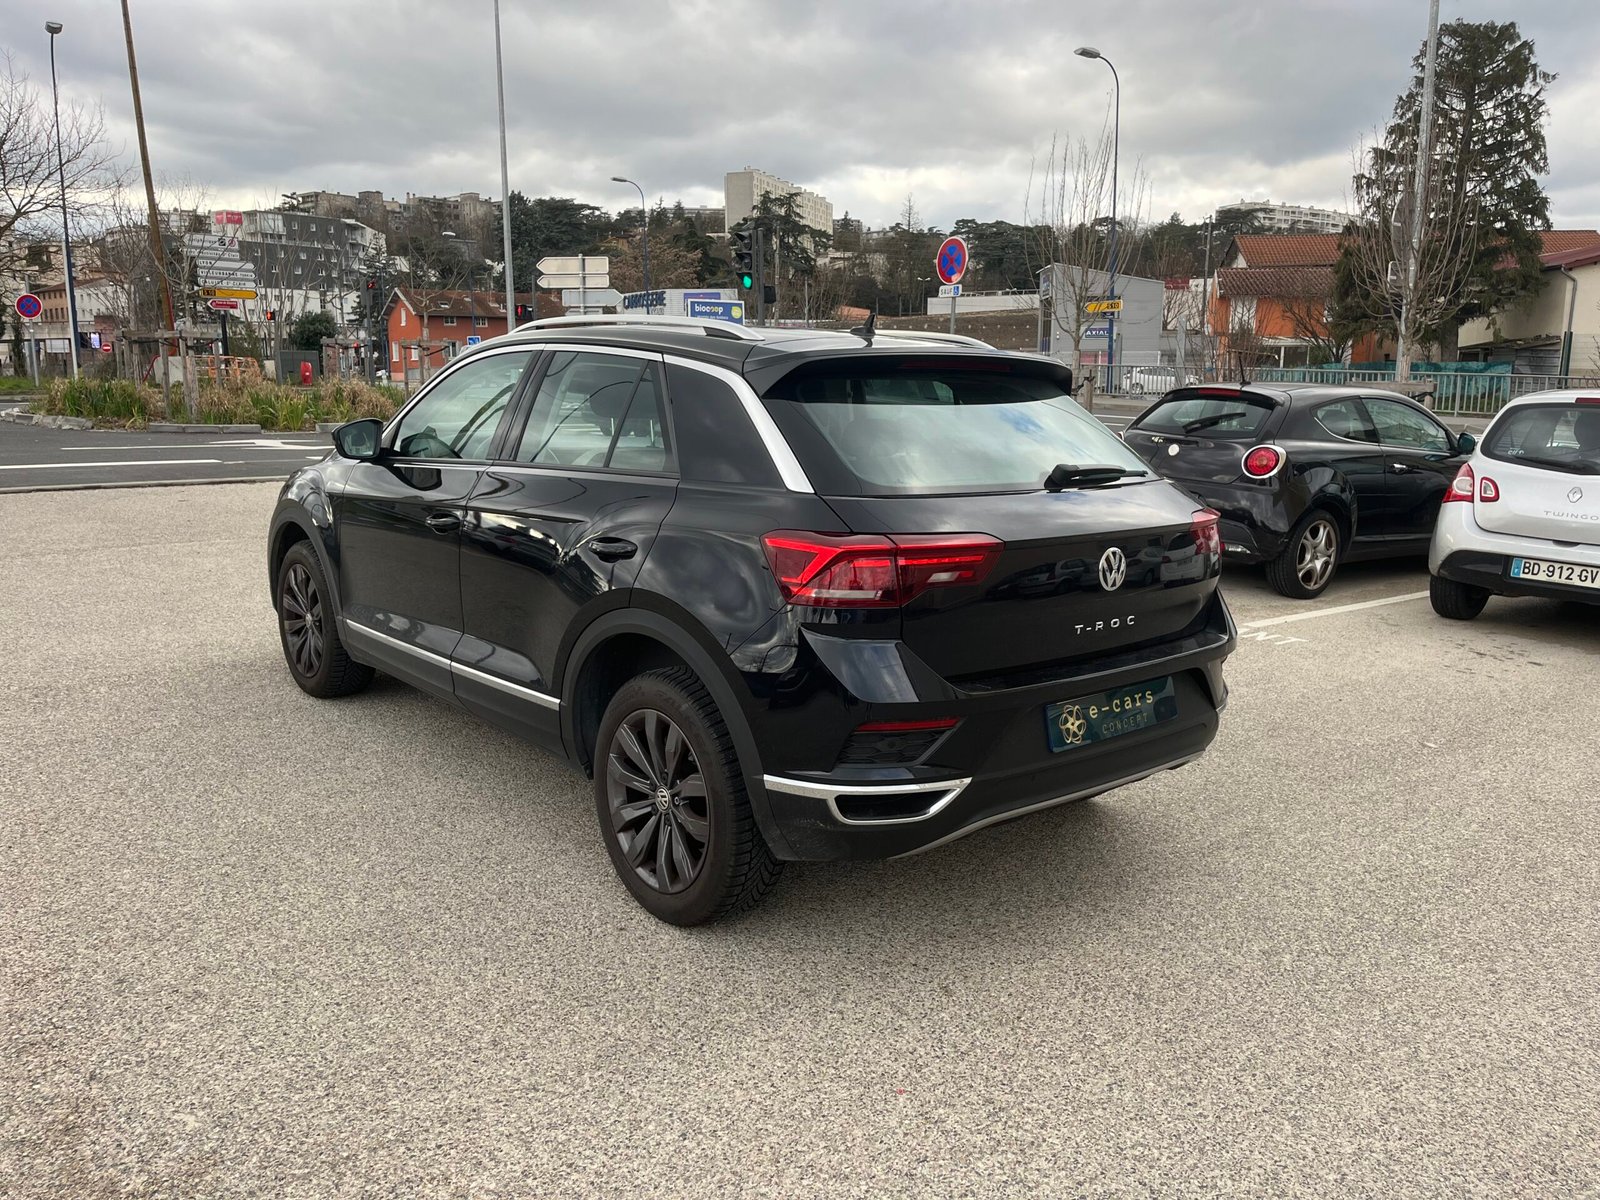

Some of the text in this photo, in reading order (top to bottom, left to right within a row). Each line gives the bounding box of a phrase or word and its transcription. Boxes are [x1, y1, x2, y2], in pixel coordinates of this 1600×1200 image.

[940, 287, 953, 296] SAUF
[694, 303, 724, 315] biocoop
[1544, 510, 1599, 521] TWINGO
[1074, 615, 1135, 635] T-ROC
[1089, 690, 1154, 719] e-cars
[1102, 713, 1148, 734] CONCEPT
